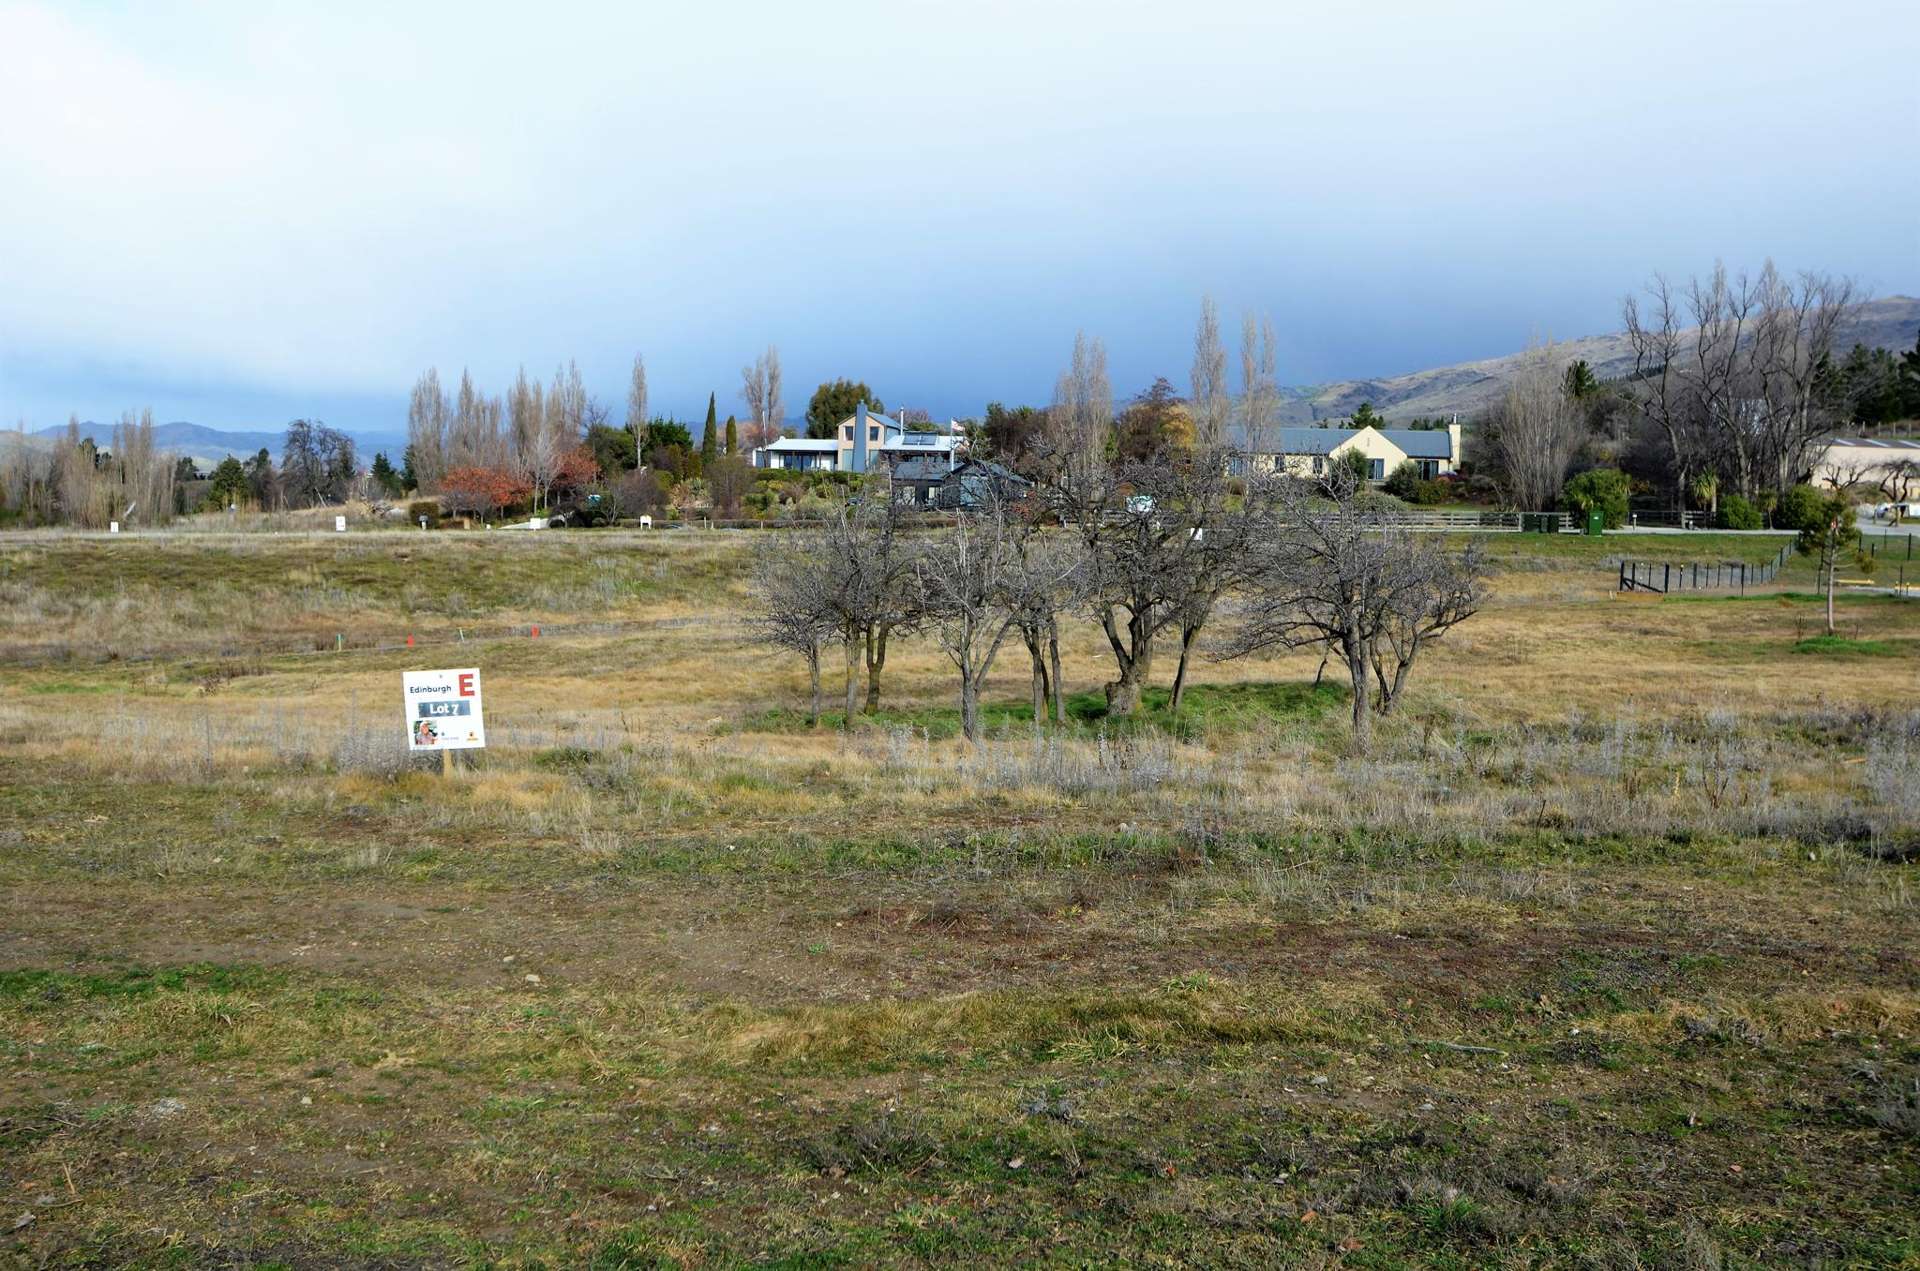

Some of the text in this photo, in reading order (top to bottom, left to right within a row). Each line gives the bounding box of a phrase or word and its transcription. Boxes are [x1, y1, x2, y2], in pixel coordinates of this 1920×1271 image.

[410, 685, 452, 694] Edinburgh
[458, 674, 475, 696] E
[430, 703, 460, 715] Lot 7
